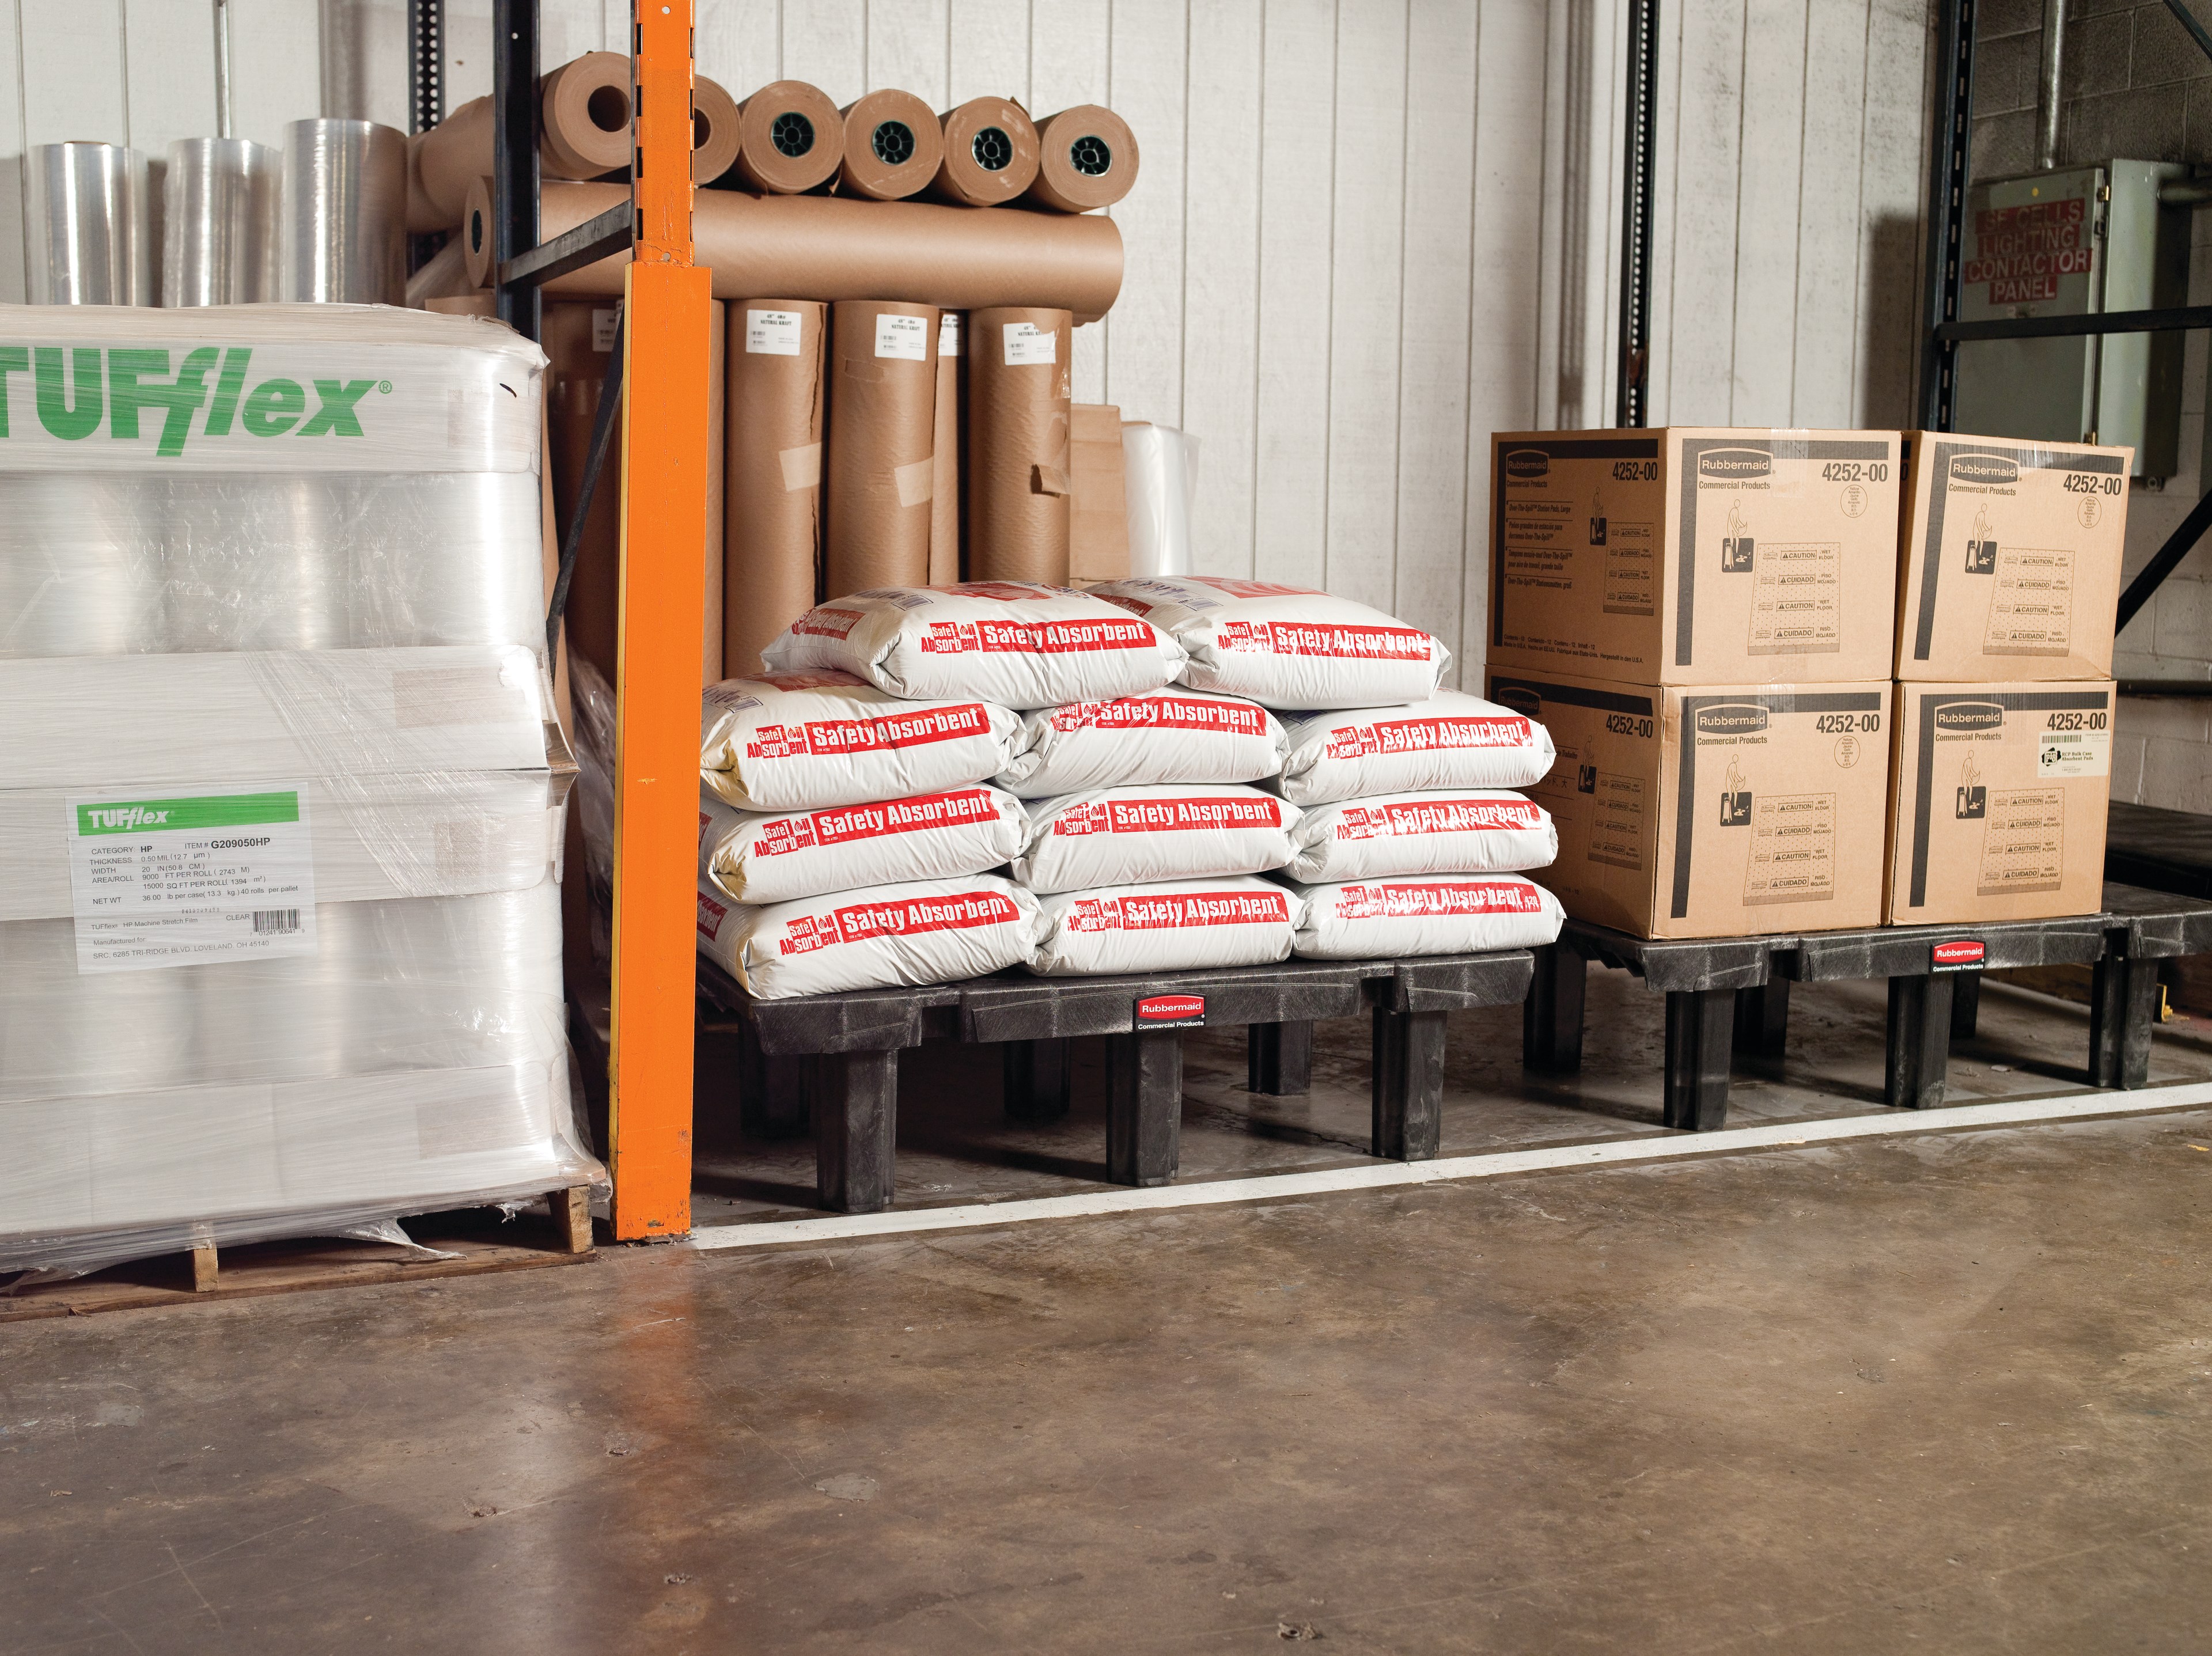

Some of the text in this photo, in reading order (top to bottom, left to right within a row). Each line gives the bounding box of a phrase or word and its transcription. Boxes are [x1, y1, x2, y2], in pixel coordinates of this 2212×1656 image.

[1983, 225, 2075, 257] LIGHTING
[1968, 249, 2088, 281] CONTACTOR
[1994, 276, 2055, 302] PANEL
[1508, 460, 1547, 469] Rubbermaid
[1612, 461, 1658, 481] 4252-00
[1702, 459, 1768, 471] Rubbermaid
[1822, 463, 1889, 482] 4252-00
[1953, 463, 2016, 478] Rubbermaid
[1506, 480, 1529, 488] Commercial
[1699, 481, 1770, 490] Commercial Products
[1949, 483, 2016, 496] Commercial Products
[2063, 474, 2122, 495] 4252-00
[931, 624, 956, 638] SafeT
[983, 622, 1146, 649] Safety Absorbent
[1228, 623, 1249, 636] SafeT
[921, 636, 980, 653] Absorbent
[1275, 626, 1425, 653] Safety Absorbent
[1501, 698, 1538, 710] Rubbermaid
[1100, 701, 1259, 727] Safety Absorbent
[1700, 715, 1765, 726] Rubbermaid
[1938, 713, 2000, 723] Rubbermaid
[2047, 712, 2107, 731] 4252-00
[813, 707, 980, 751] Safety Absorbent
[1606, 714, 1654, 738] 4252-00
[1816, 714, 1880, 733] 4252-00
[759, 726, 783, 742] SafeT
[1335, 728, 1357, 744] SafeT
[1380, 721, 1525, 749] Safety Absorbent
[1697, 736, 1767, 746] Commercial Products
[1936, 732, 2002, 742] Commercial Products
[747, 739, 809, 759] Absorbent
[818, 794, 990, 836] Safety Absorbent
[1065, 804, 1090, 820] SafeT
[1115, 801, 1272, 826] Safety Absorbent
[1344, 809, 1367, 823] SafeT
[1392, 805, 1533, 831] Safety Absorbent
[764, 821, 791, 839] SafeT
[1053, 817, 1109, 836] Absorbent
[92, 847, 135, 855] CATEGORY:
[211, 838, 270, 849] G209050HP
[753, 832, 816, 858] Absorbent
[89, 857, 132, 865] THICKNESS
[92, 876, 134, 884] AREA/ROLL
[1344, 888, 1365, 903] SafeT
[1387, 888, 1439, 911] Safety
[1440, 887, 1524, 911] Absorbent
[842, 898, 1010, 934] Safety Absorbent
[1077, 900, 1100, 916] SafeT
[1126, 896, 1280, 923] Safety Absorbent
[789, 918, 815, 937] SafeT
[93, 937, 135, 946] Manufactured
[779, 929, 841, 955] Absorbent
[131, 948, 169, 956] TRI-RIDGE
[1937, 947, 1982, 957] Rubbermaid
[1142, 1002, 1201, 1013] Rubbermaid
